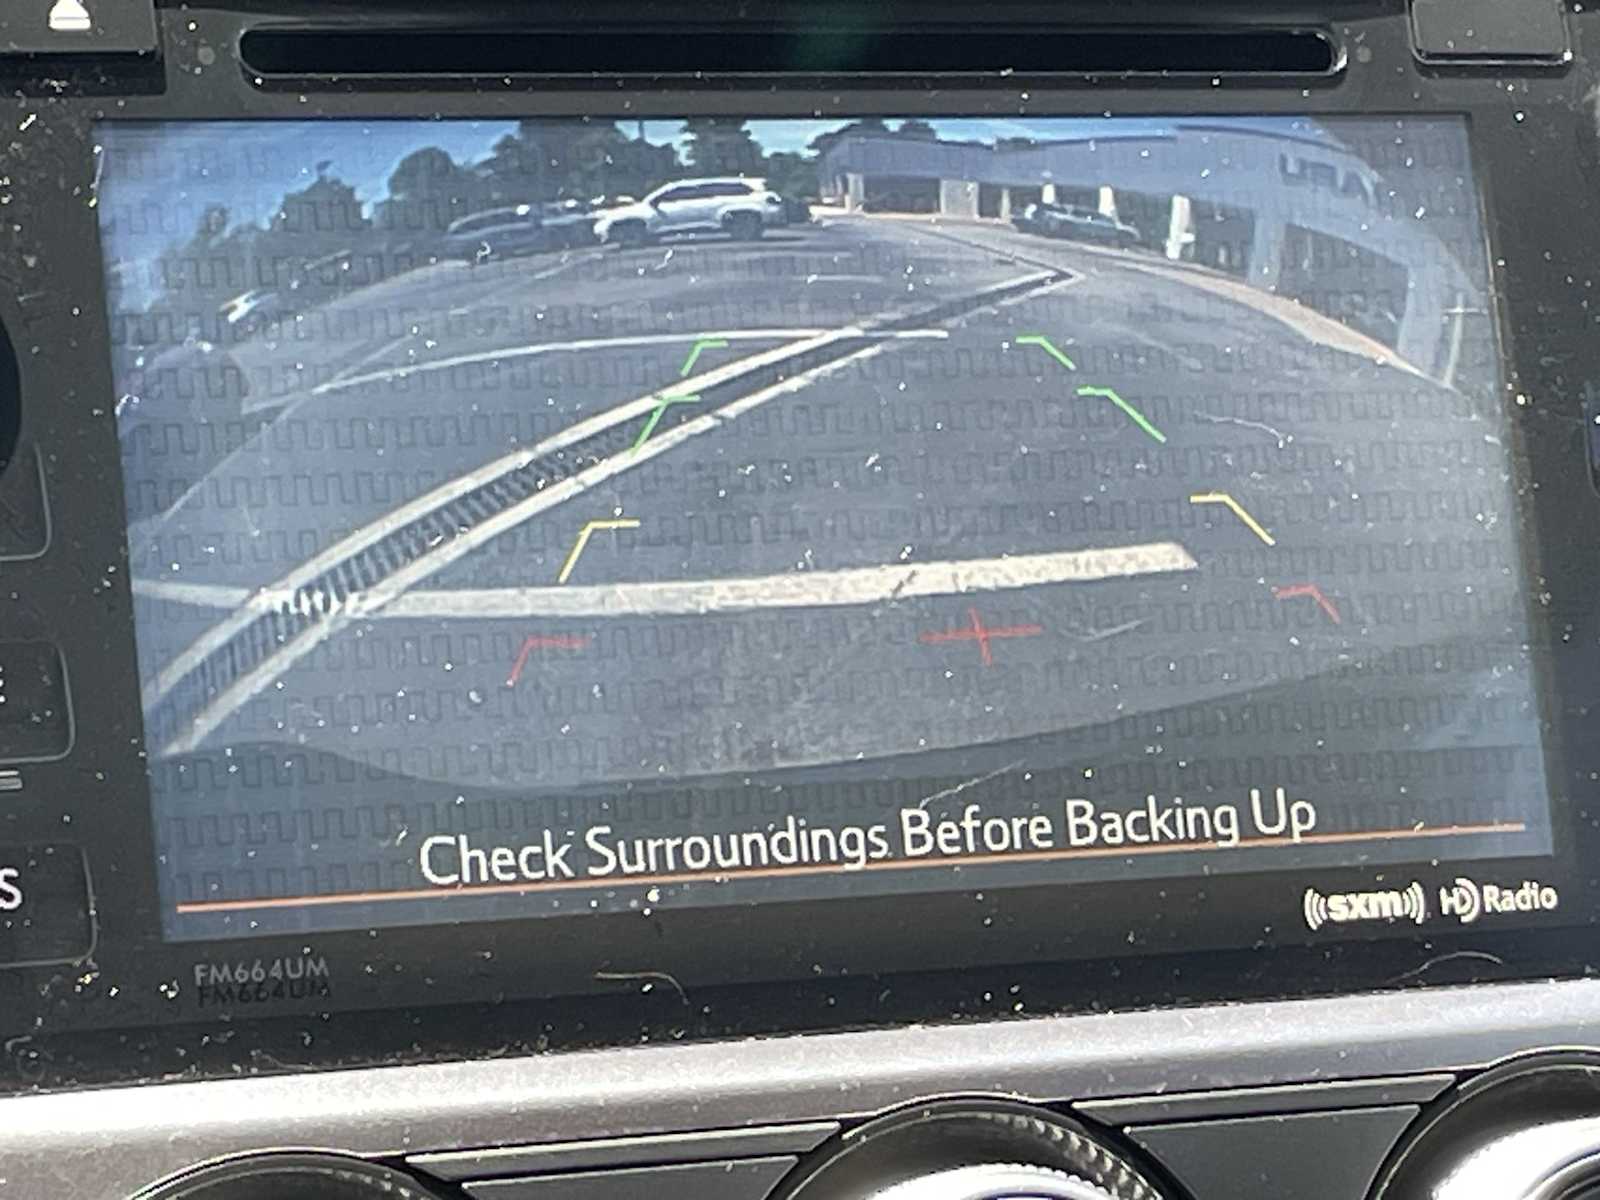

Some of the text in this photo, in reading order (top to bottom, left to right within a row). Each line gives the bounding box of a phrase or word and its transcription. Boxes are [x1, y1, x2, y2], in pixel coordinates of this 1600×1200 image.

[419, 787, 1317, 885] Check Surroundings Before Backing Up
[1439, 877, 1559, 923] HD Radio
[193, 956, 330, 986] FM664UM
